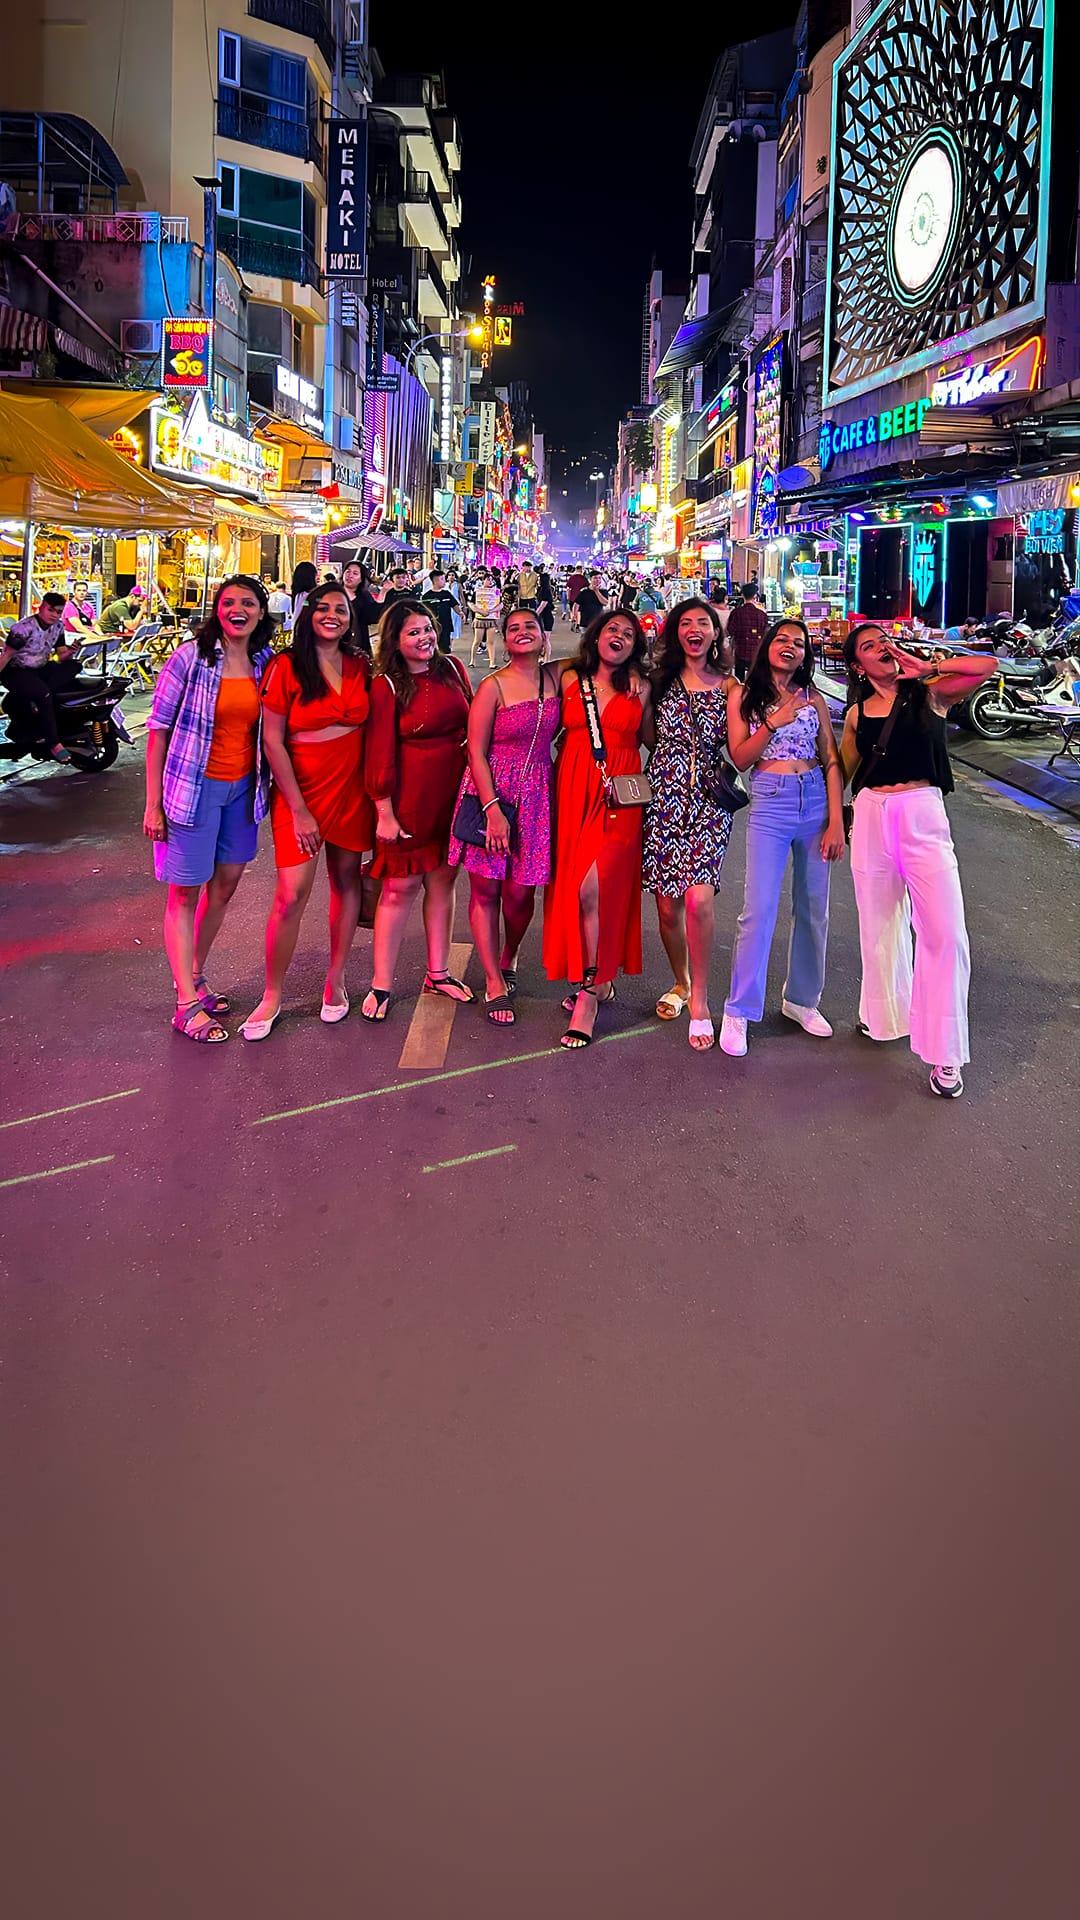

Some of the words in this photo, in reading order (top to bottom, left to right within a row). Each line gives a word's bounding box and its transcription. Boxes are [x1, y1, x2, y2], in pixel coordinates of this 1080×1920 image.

[338, 128, 358, 246] MERAKI
[330, 253, 361, 270] HOTEL
[372, 278, 397, 288] Hotel
[170, 334, 204, 353] BBQ
[833, 420, 863, 454] CAFE
[866, 416, 876, 444] &
